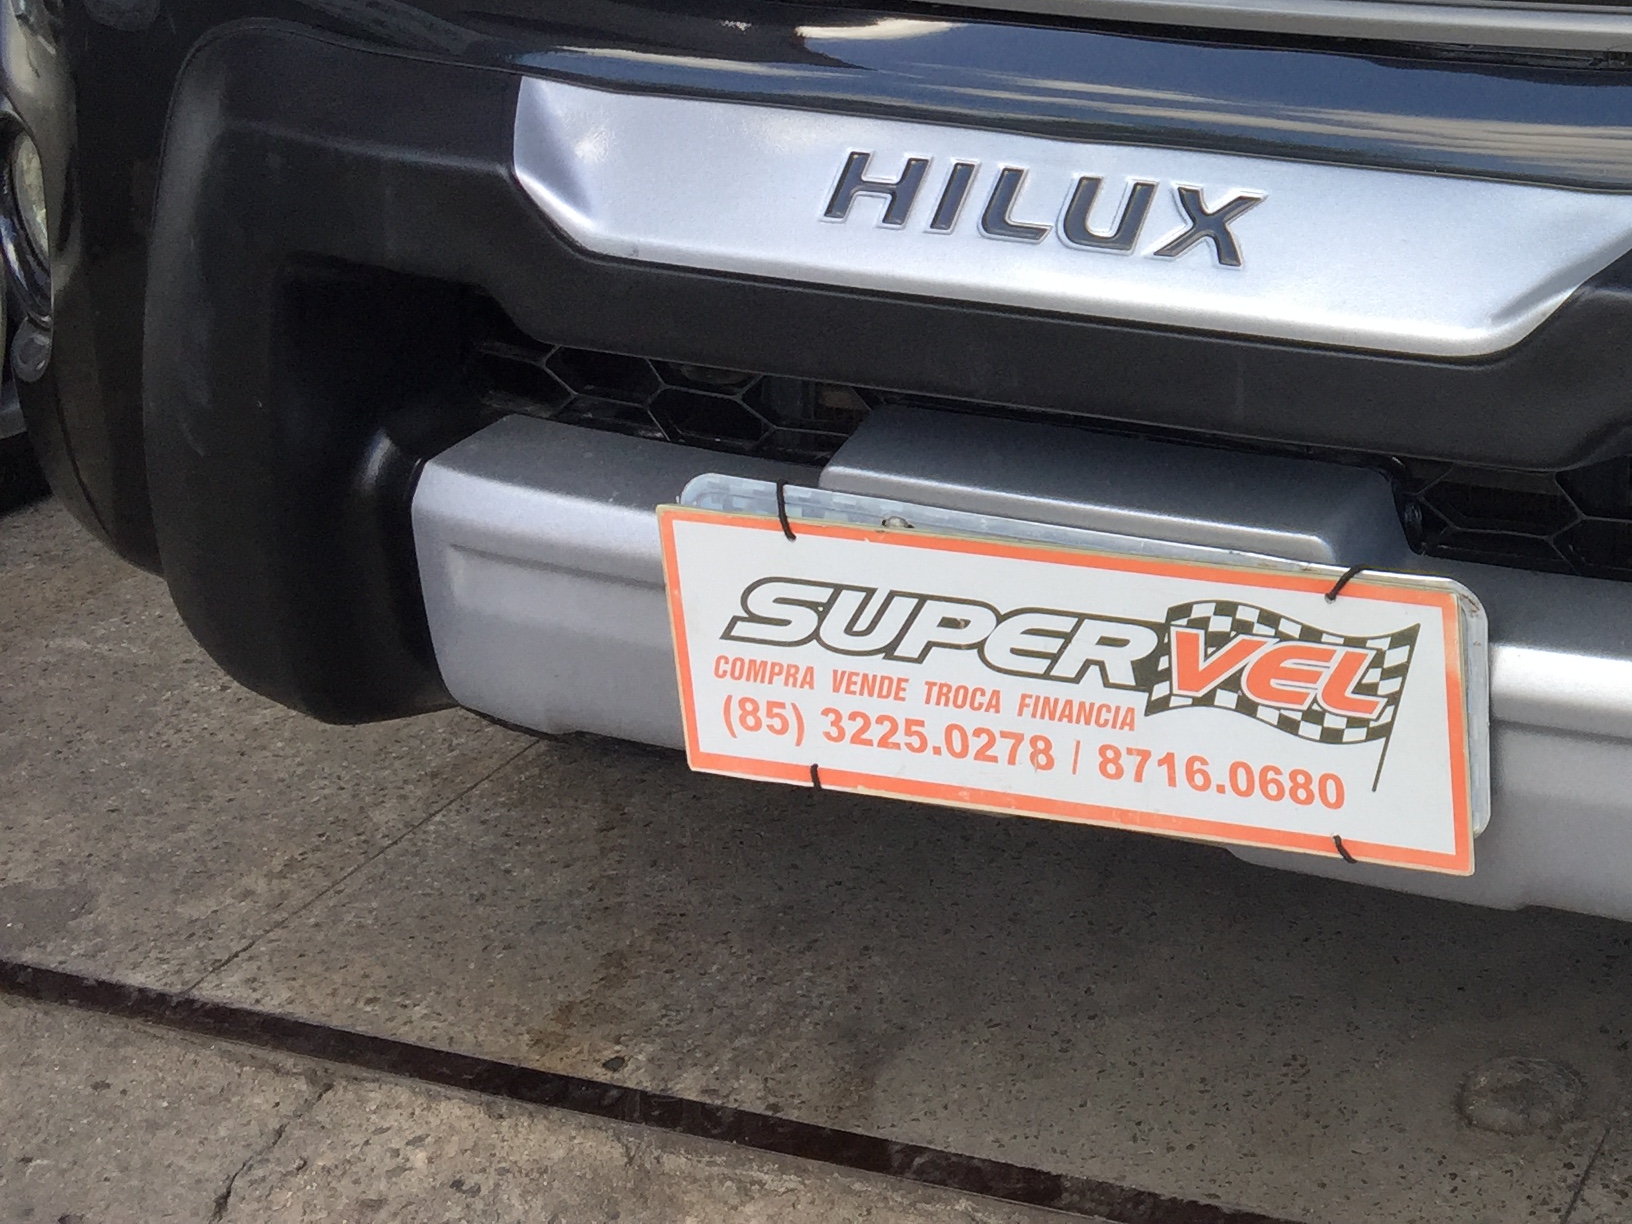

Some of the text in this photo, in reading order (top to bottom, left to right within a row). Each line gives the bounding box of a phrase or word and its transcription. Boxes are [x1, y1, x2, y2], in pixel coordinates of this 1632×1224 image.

[822, 148, 1266, 269] HILUX
[713, 654, 1136, 732] COMPRA VENDE TROCA FINANCIA
[722, 694, 805, 748] (85)
[819, 707, 1056, 772] 3225.0278
[1098, 743, 1345, 810] 8716.0680
